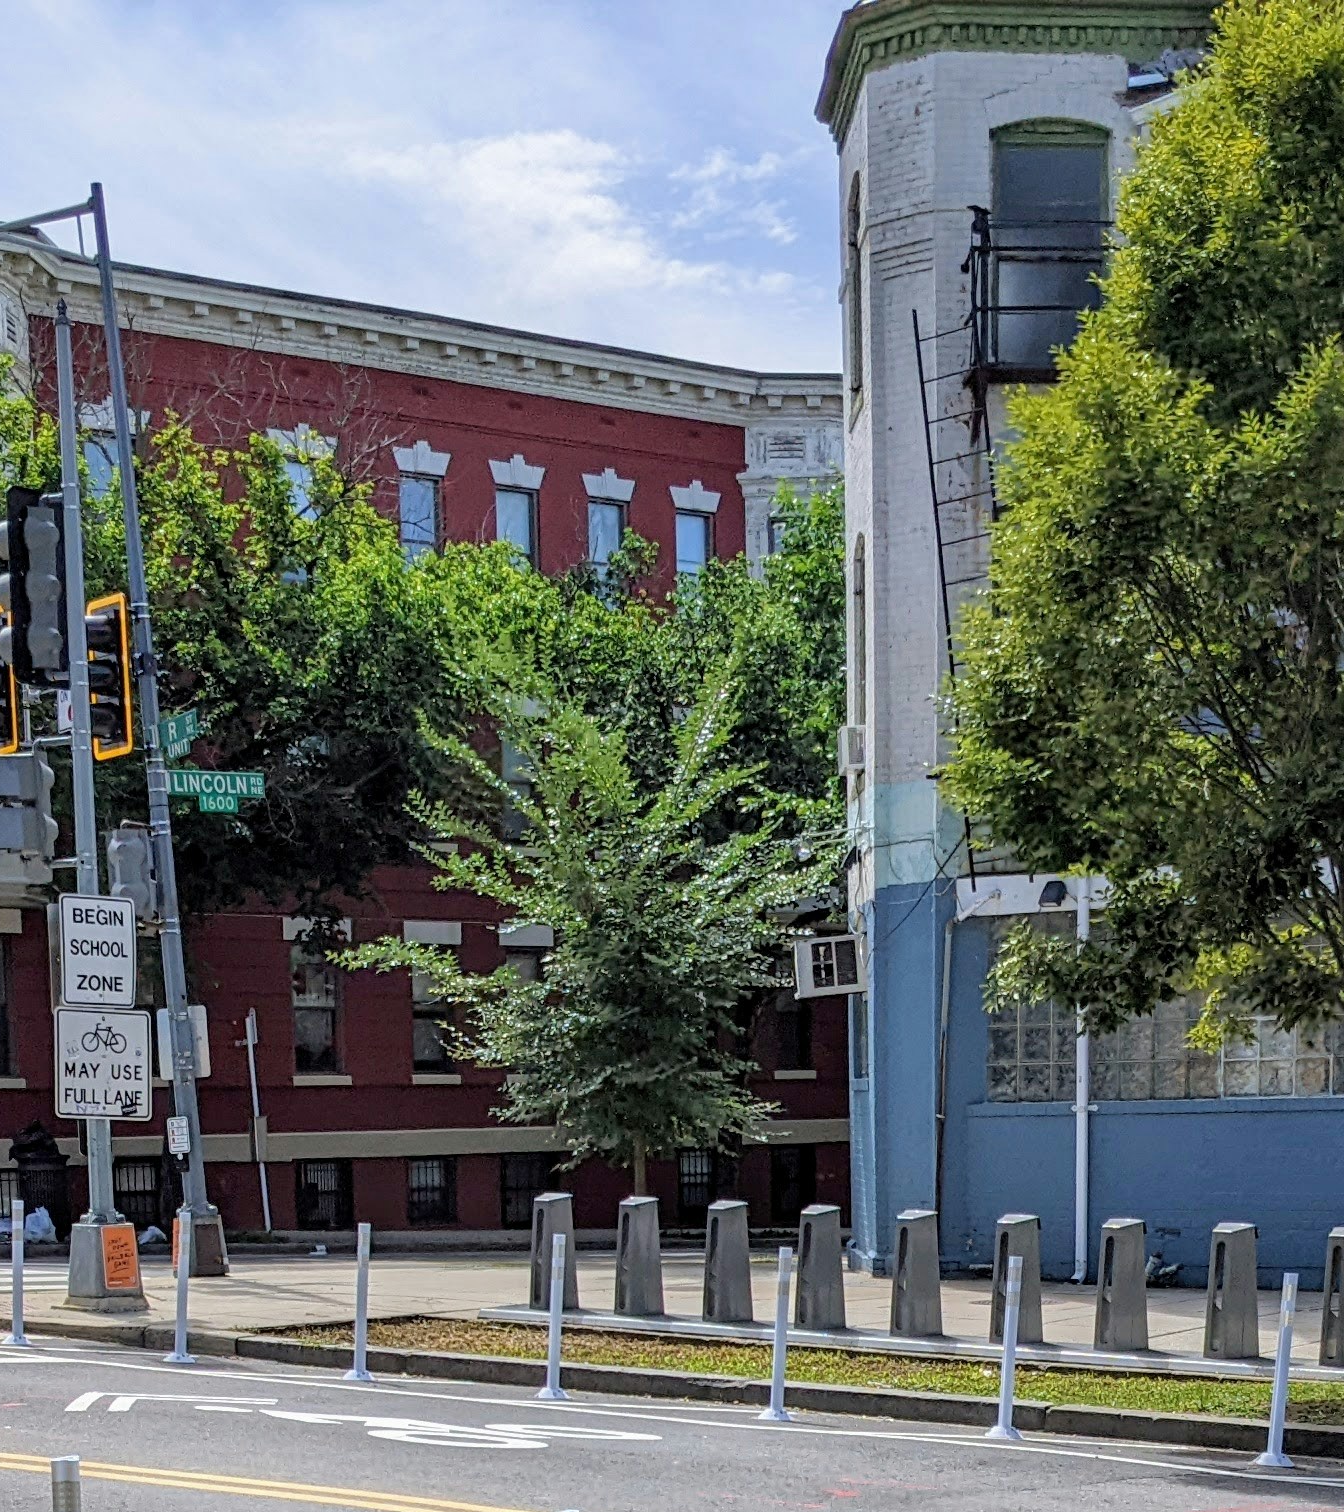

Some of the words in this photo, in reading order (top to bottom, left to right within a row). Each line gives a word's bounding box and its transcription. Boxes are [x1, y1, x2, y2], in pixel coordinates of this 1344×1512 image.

[168, 721, 177, 742] R
[167, 738, 189, 759] UNIT
[174, 774, 247, 795] LINCOLN
[250, 777, 263, 786] RD
[250, 786, 264, 795] NE
[202, 796, 234, 811] 1600
[72, 908, 124, 927] BEGIN
[70, 939, 128, 959] SCHOOL
[76, 974, 124, 993] ZONE
[64, 1062, 101, 1079] MAY
[111, 1064, 143, 1081] USE
[64, 1088, 101, 1105] FULL
[104, 1090, 143, 1106] LANE
